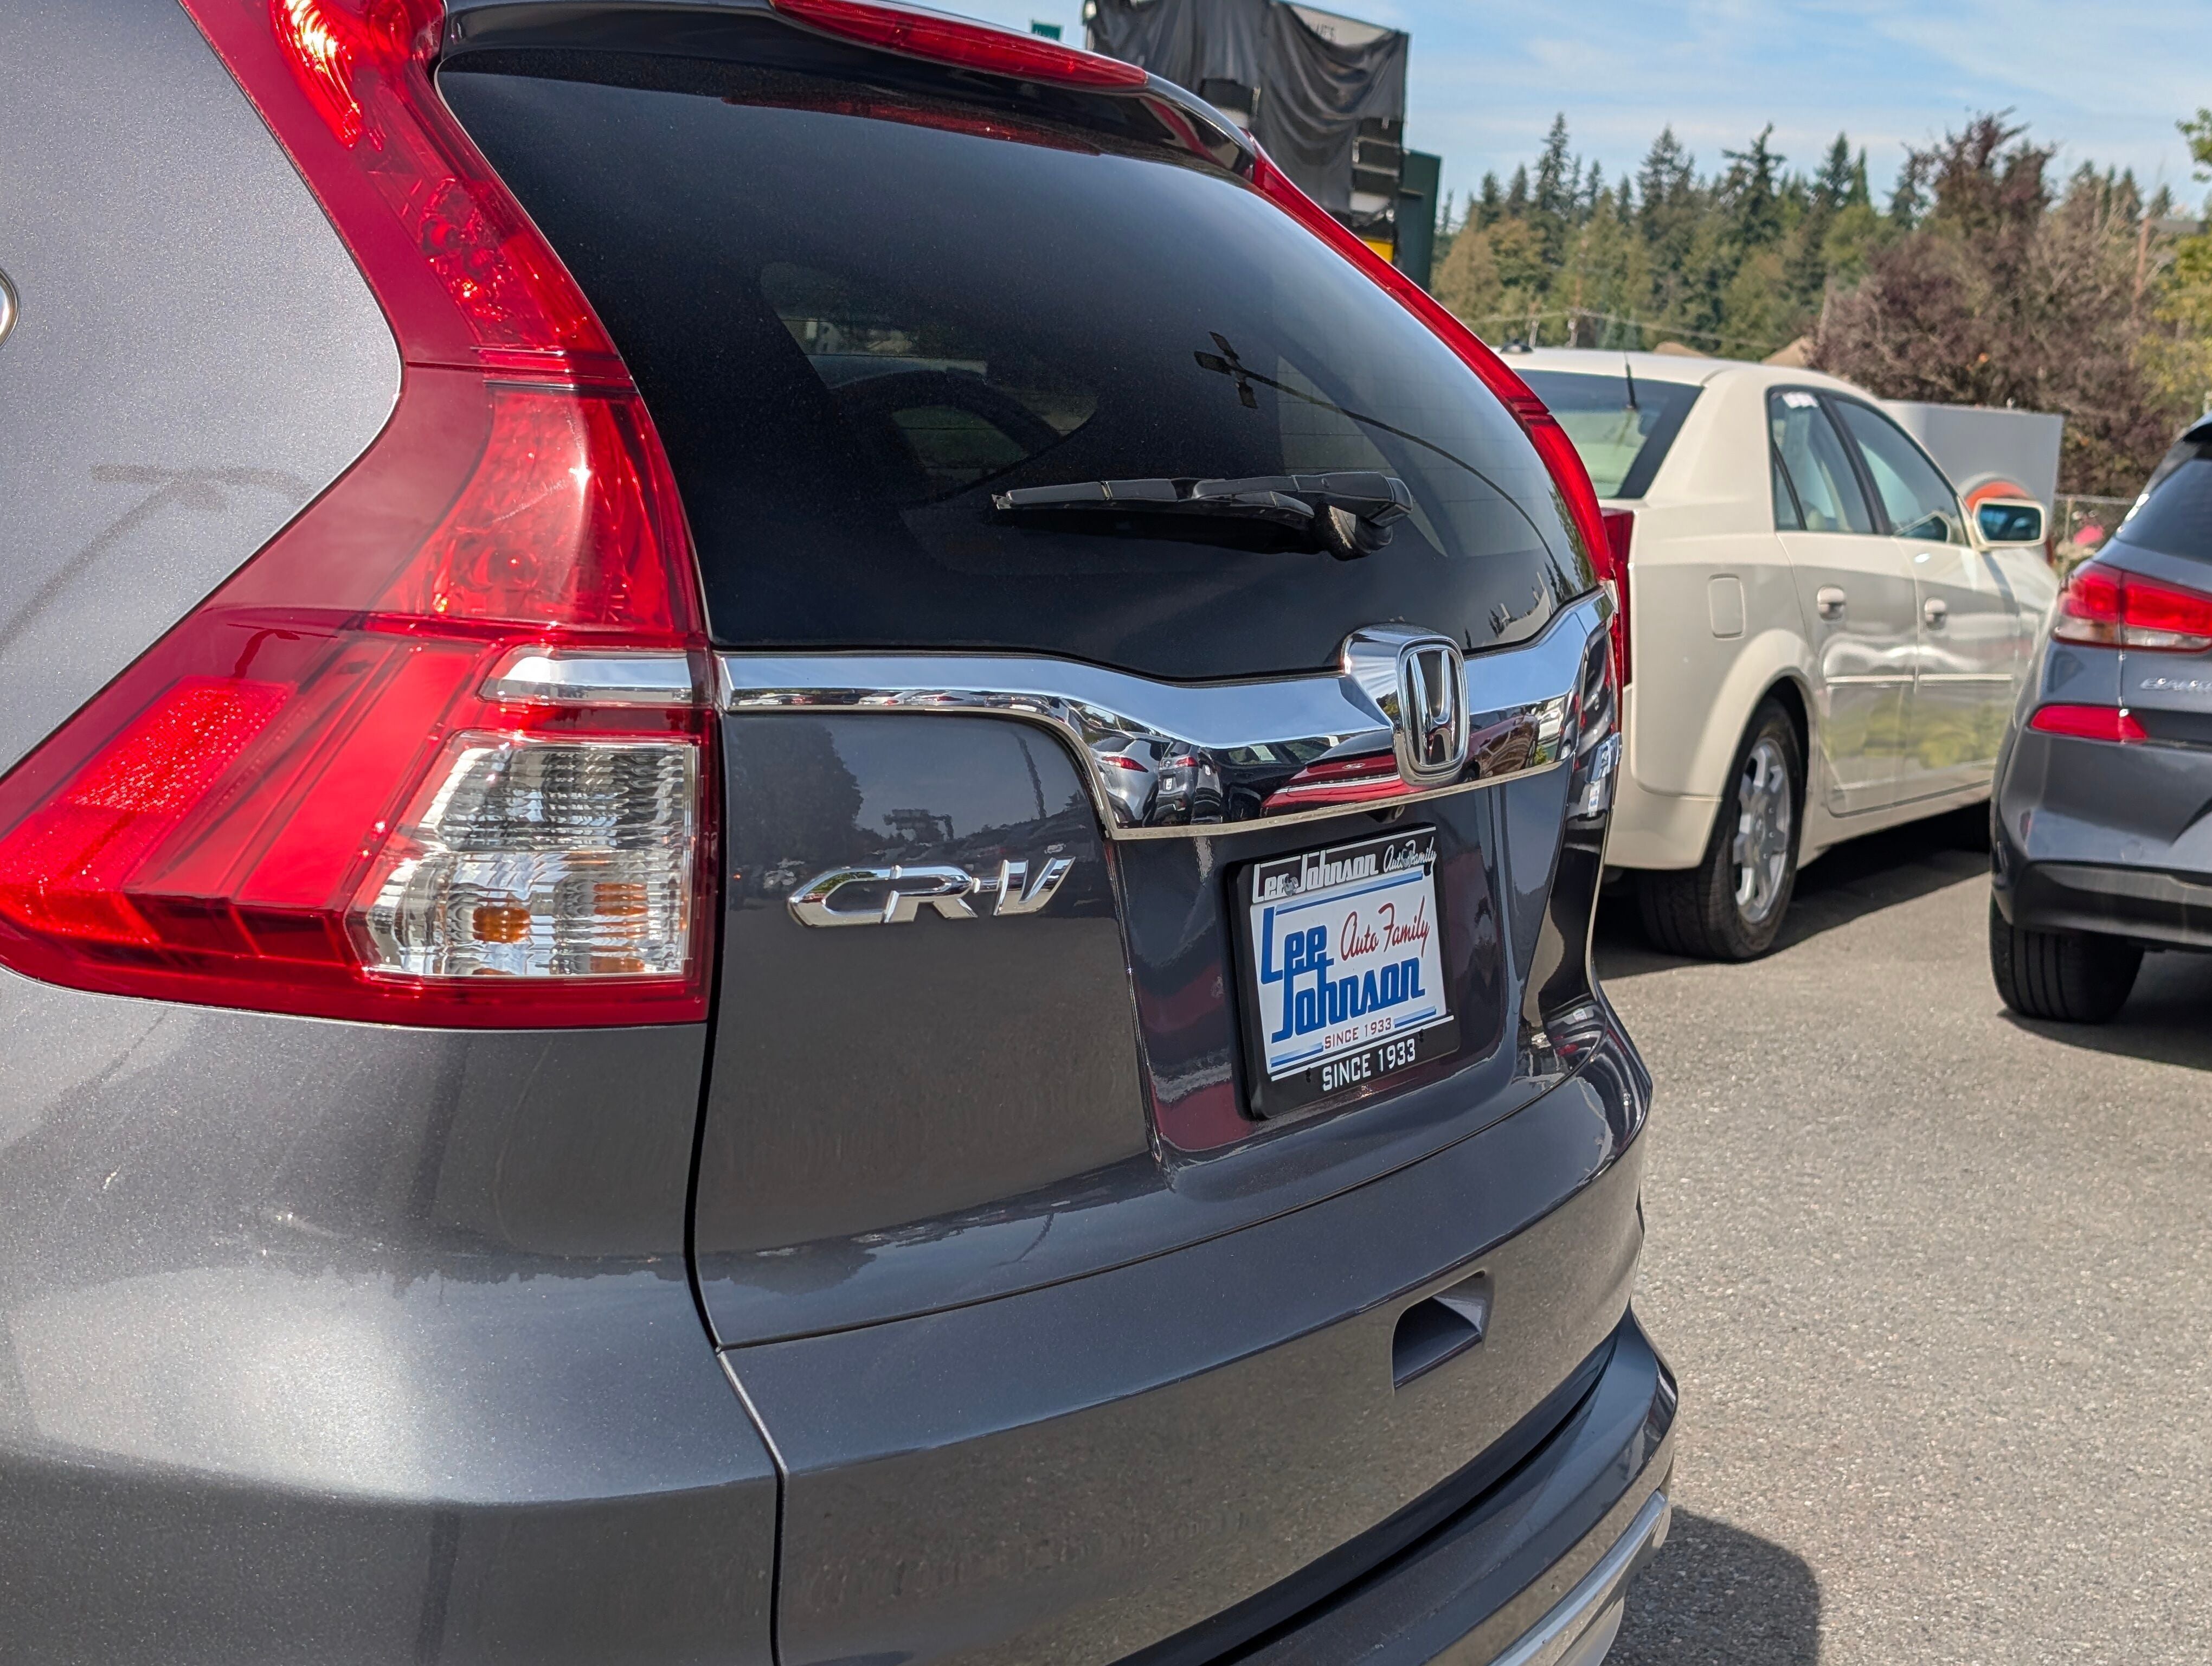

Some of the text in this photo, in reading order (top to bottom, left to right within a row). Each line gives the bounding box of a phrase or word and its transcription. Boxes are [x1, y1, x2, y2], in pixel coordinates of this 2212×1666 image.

[788, 856, 1076, 927] CR-V
[1295, 850, 1379, 894] Johnson
[1383, 844, 1409, 873] Aut
[1261, 895, 1430, 984] Lee Auto Family
[1271, 957, 1425, 1044] Johnson
[1324, 1017, 1392, 1049] SINCE 1933
[1323, 1039, 1416, 1091] SINCE 1933
